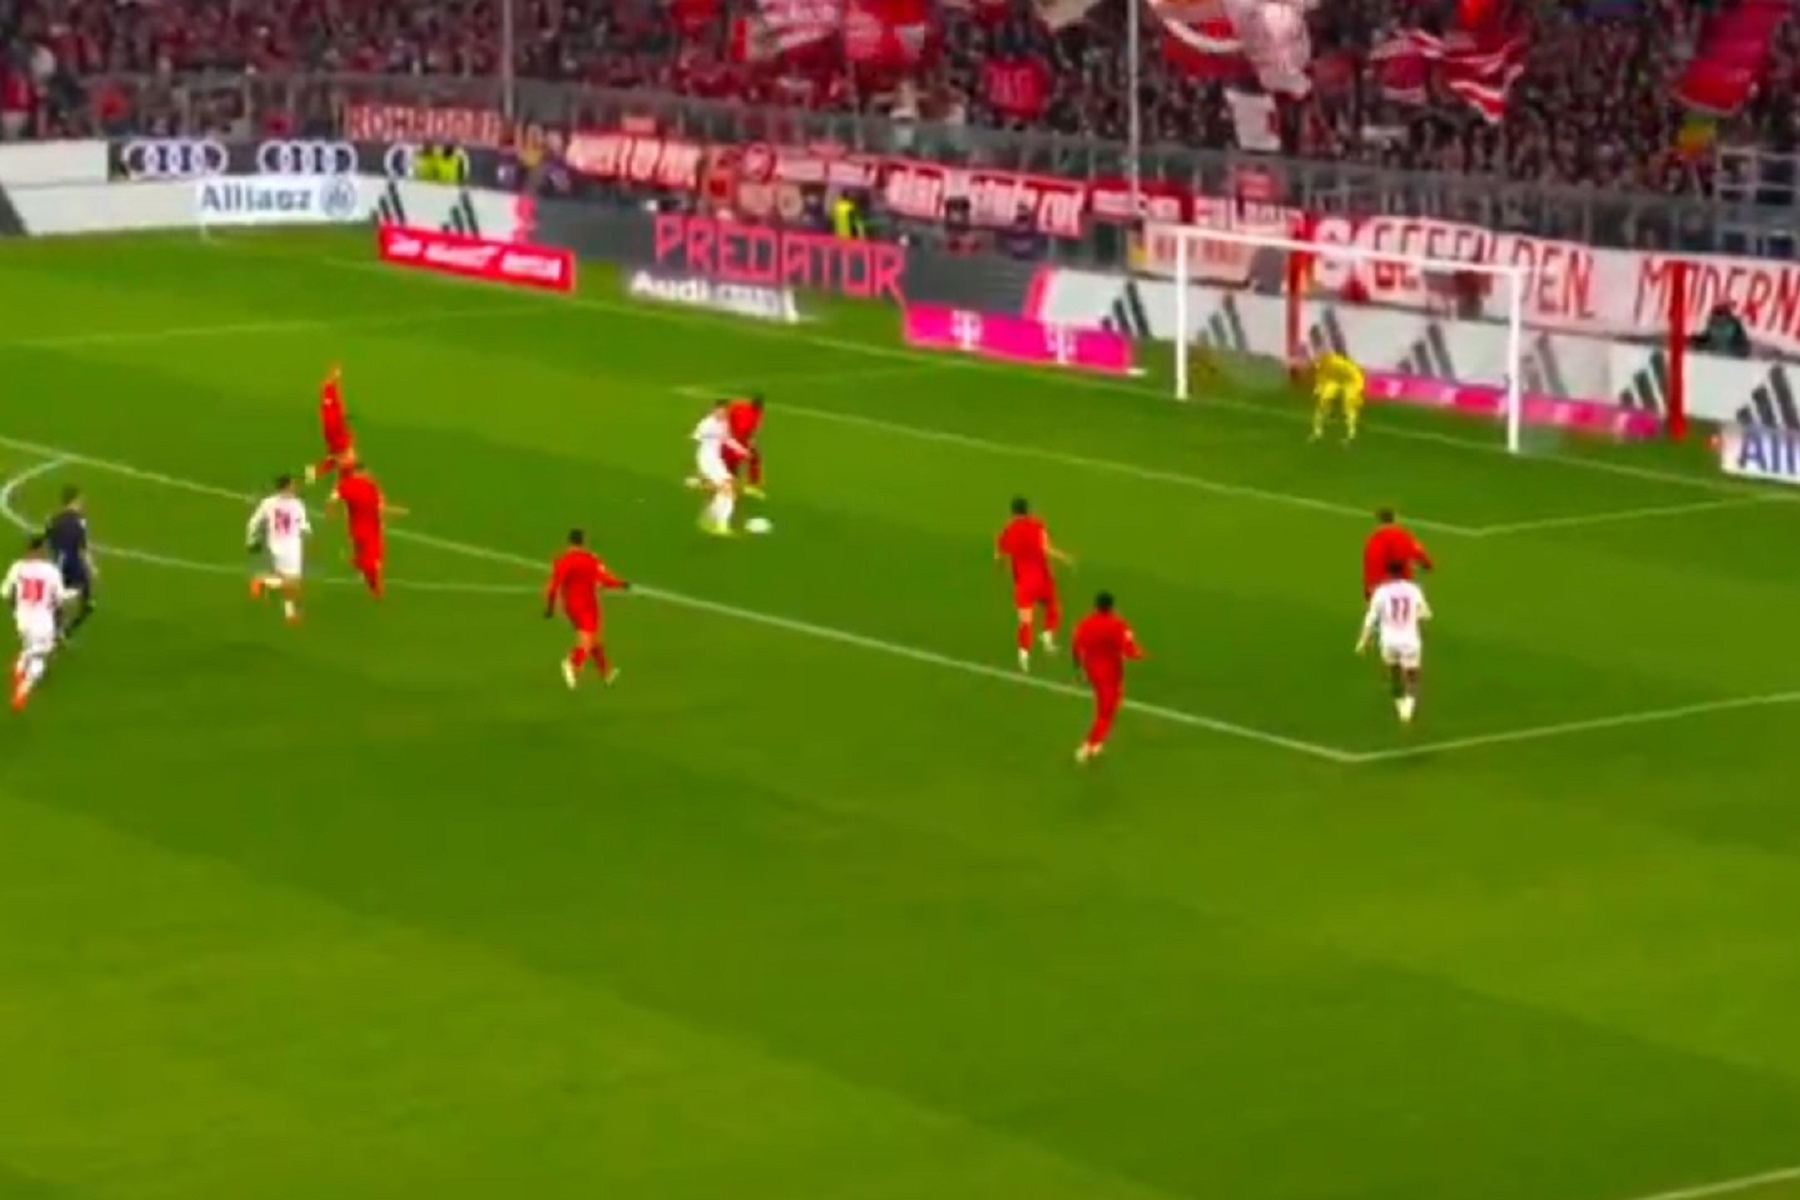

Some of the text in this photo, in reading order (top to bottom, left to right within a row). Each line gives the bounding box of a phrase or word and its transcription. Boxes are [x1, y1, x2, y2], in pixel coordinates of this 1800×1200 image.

[201, 183, 313, 211] Allianz
[655, 214, 906, 300] PREDATOR
[631, 270, 710, 304] Audi
